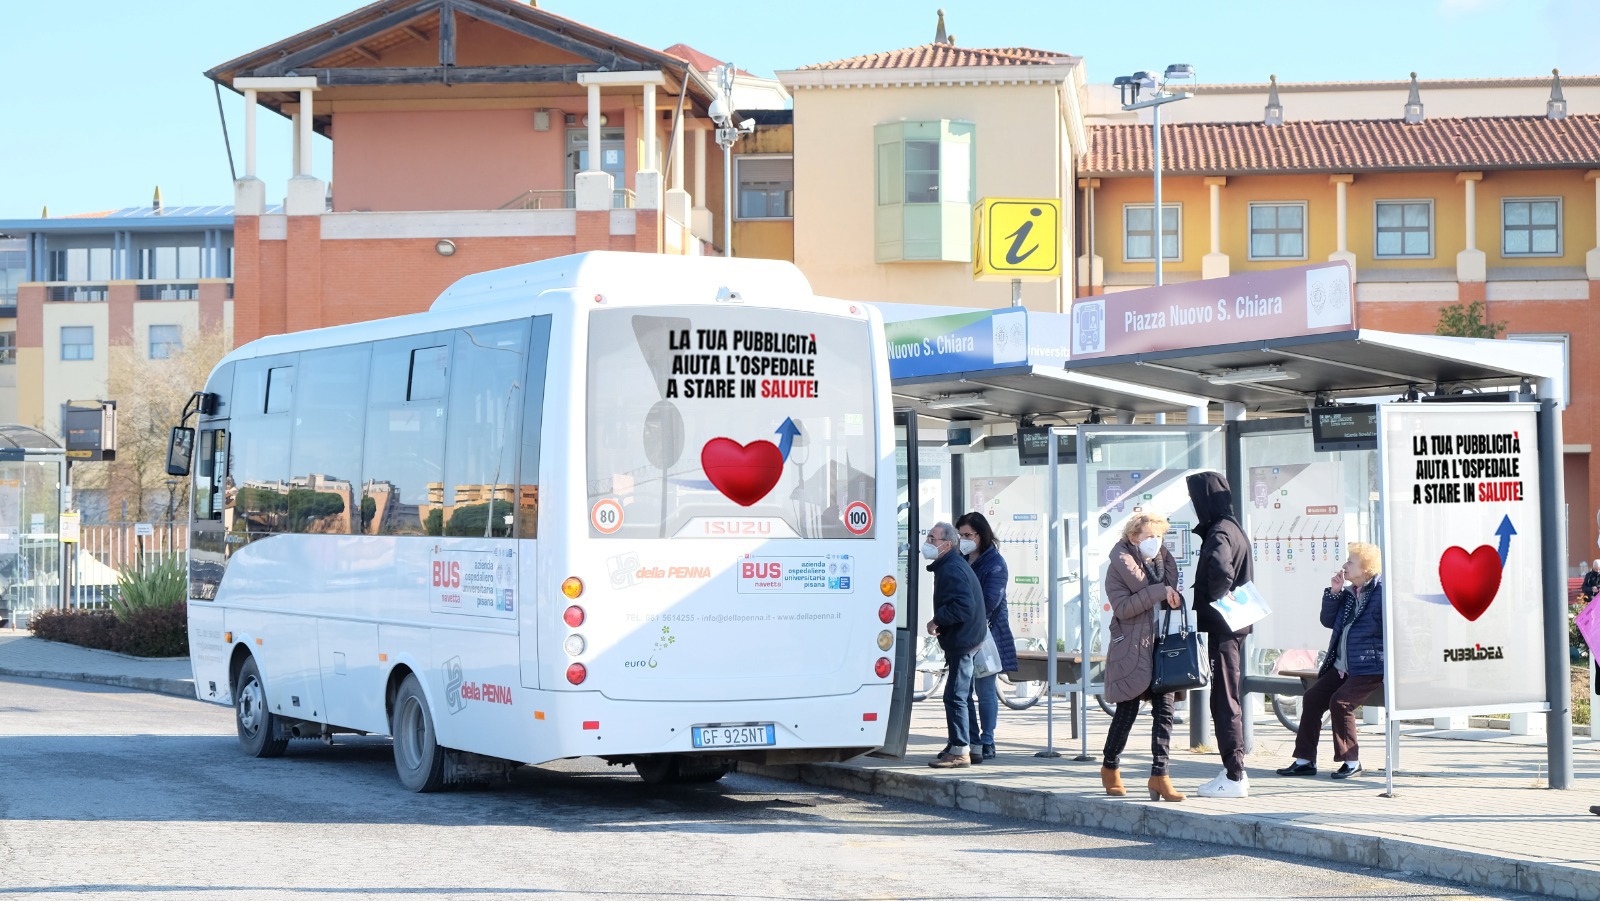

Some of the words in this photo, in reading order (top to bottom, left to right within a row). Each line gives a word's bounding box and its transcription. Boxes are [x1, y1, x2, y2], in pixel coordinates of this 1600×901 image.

[1125, 311, 1165, 332] Piazza
[1170, 305, 1212, 326] Nuovo
[1217, 299, 1230, 321] S.
[1236, 295, 1282, 318] Chiara
[669, 330, 690, 350] LA
[697, 330, 727, 350] TUA
[733, 331, 817, 354] PUBBLICITÀ
[888, 342, 920, 359] Nuovo
[923, 337, 934, 356] S.
[937, 334, 974, 354] Chiara
[672, 355, 720, 375] AIUTA
[727, 355, 814, 376] L'OSPEDALE
[666, 379, 678, 398] A
[684, 379, 735, 398] STARE
[741, 379, 756, 398] IN
[761, 380, 818, 398] SALUTE!
[1413, 435, 1428, 455] LA
[1431, 435, 1453, 455] TUA
[1456, 431, 1521, 454] PUBBLICITÀ
[1416, 459, 1450, 479] AIUTA
[1452, 458, 1520, 478] L'OSPEDALE
[1413, 484, 1421, 504] A
[1424, 483, 1460, 503] STARE
[1463, 483, 1475, 502] IN
[1478, 481, 1523, 502] SALUTE!
[600, 509, 615, 523] 80
[850, 511, 867, 525] 100
[704, 521, 770, 534] ISUZU
[475, 560, 493, 570] azienda
[636, 567, 665, 578] della
[668, 567, 711, 578] PENNA
[742, 563, 781, 579] BUS
[433, 561, 460, 588] BUS
[465, 572, 493, 583] ospedaliero
[442, 594, 460, 603] navetta
[477, 595, 493, 608] pisana
[662, 614, 695, 622] 5614255
[701, 613, 771, 623] info@dellapenna.it
[777, 612, 841, 622] www.dellapenna.it
[624, 659, 646, 668] euro
[461, 681, 480, 700] della
[482, 683, 512, 705] PENNA
[703, 729, 718, 744] GF
[724, 727, 764, 744] 925NT
